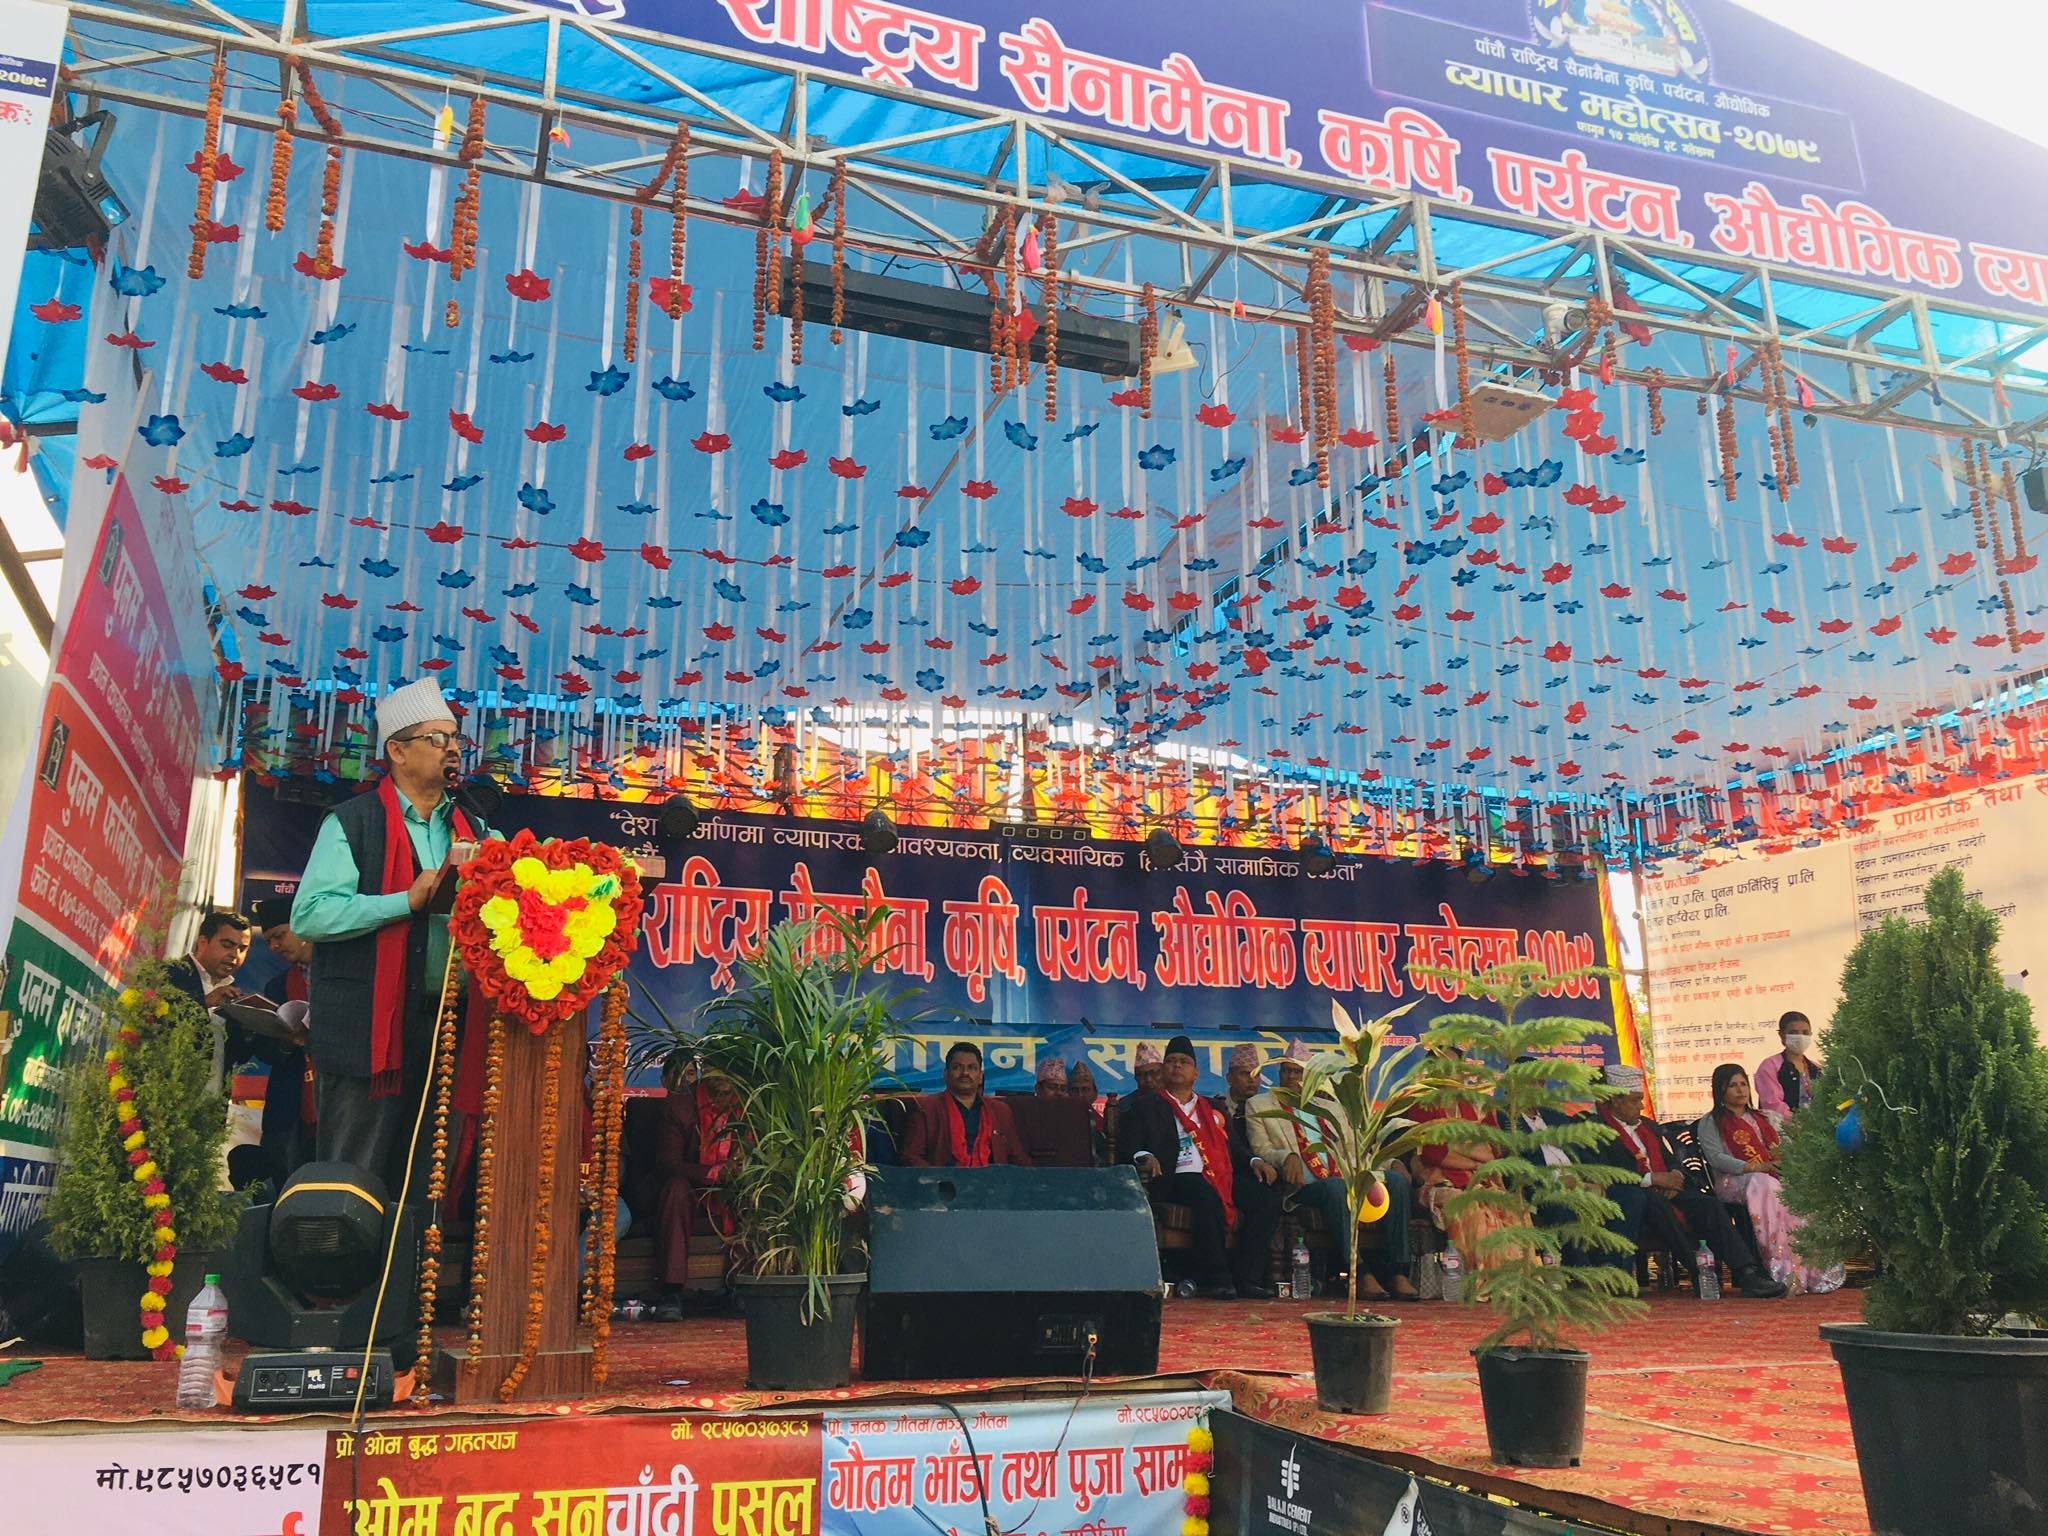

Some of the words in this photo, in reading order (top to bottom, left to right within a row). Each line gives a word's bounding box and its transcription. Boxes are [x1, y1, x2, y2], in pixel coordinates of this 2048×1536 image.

[1564, 57, 1620, 86] सैनामैना
[1445, 60, 1568, 112] व्यापार
[1579, 93, 1821, 163] महोत्सव-२०७९
[1487, 150, 1694, 249] पर्यटन,
[1704, 181, 1962, 289] औद्योगिक
[61, 751, 104, 828] पुनम
[1214, 856, 1300, 878] सामाजिक
[943, 875, 1025, 1003] कृषि,
[1033, 886, 1146, 991] पर्यटन,
[1152, 885, 1296, 989] औद्योगिक
[1300, 918, 1403, 999] व्यापार
[365, 1432, 403, 1456] ओम
[408, 1434, 440, 1460] बुद्ध
[444, 1431, 518, 1454] गहतराज
[849, 1419, 887, 1436] जनक
[972, 1411, 1008, 1430] गौतम
[828, 1440, 915, 1514] गौतम
[1001, 1450, 1059, 1504] तथा
[1287, 1502, 1312, 1525] CEMENT
